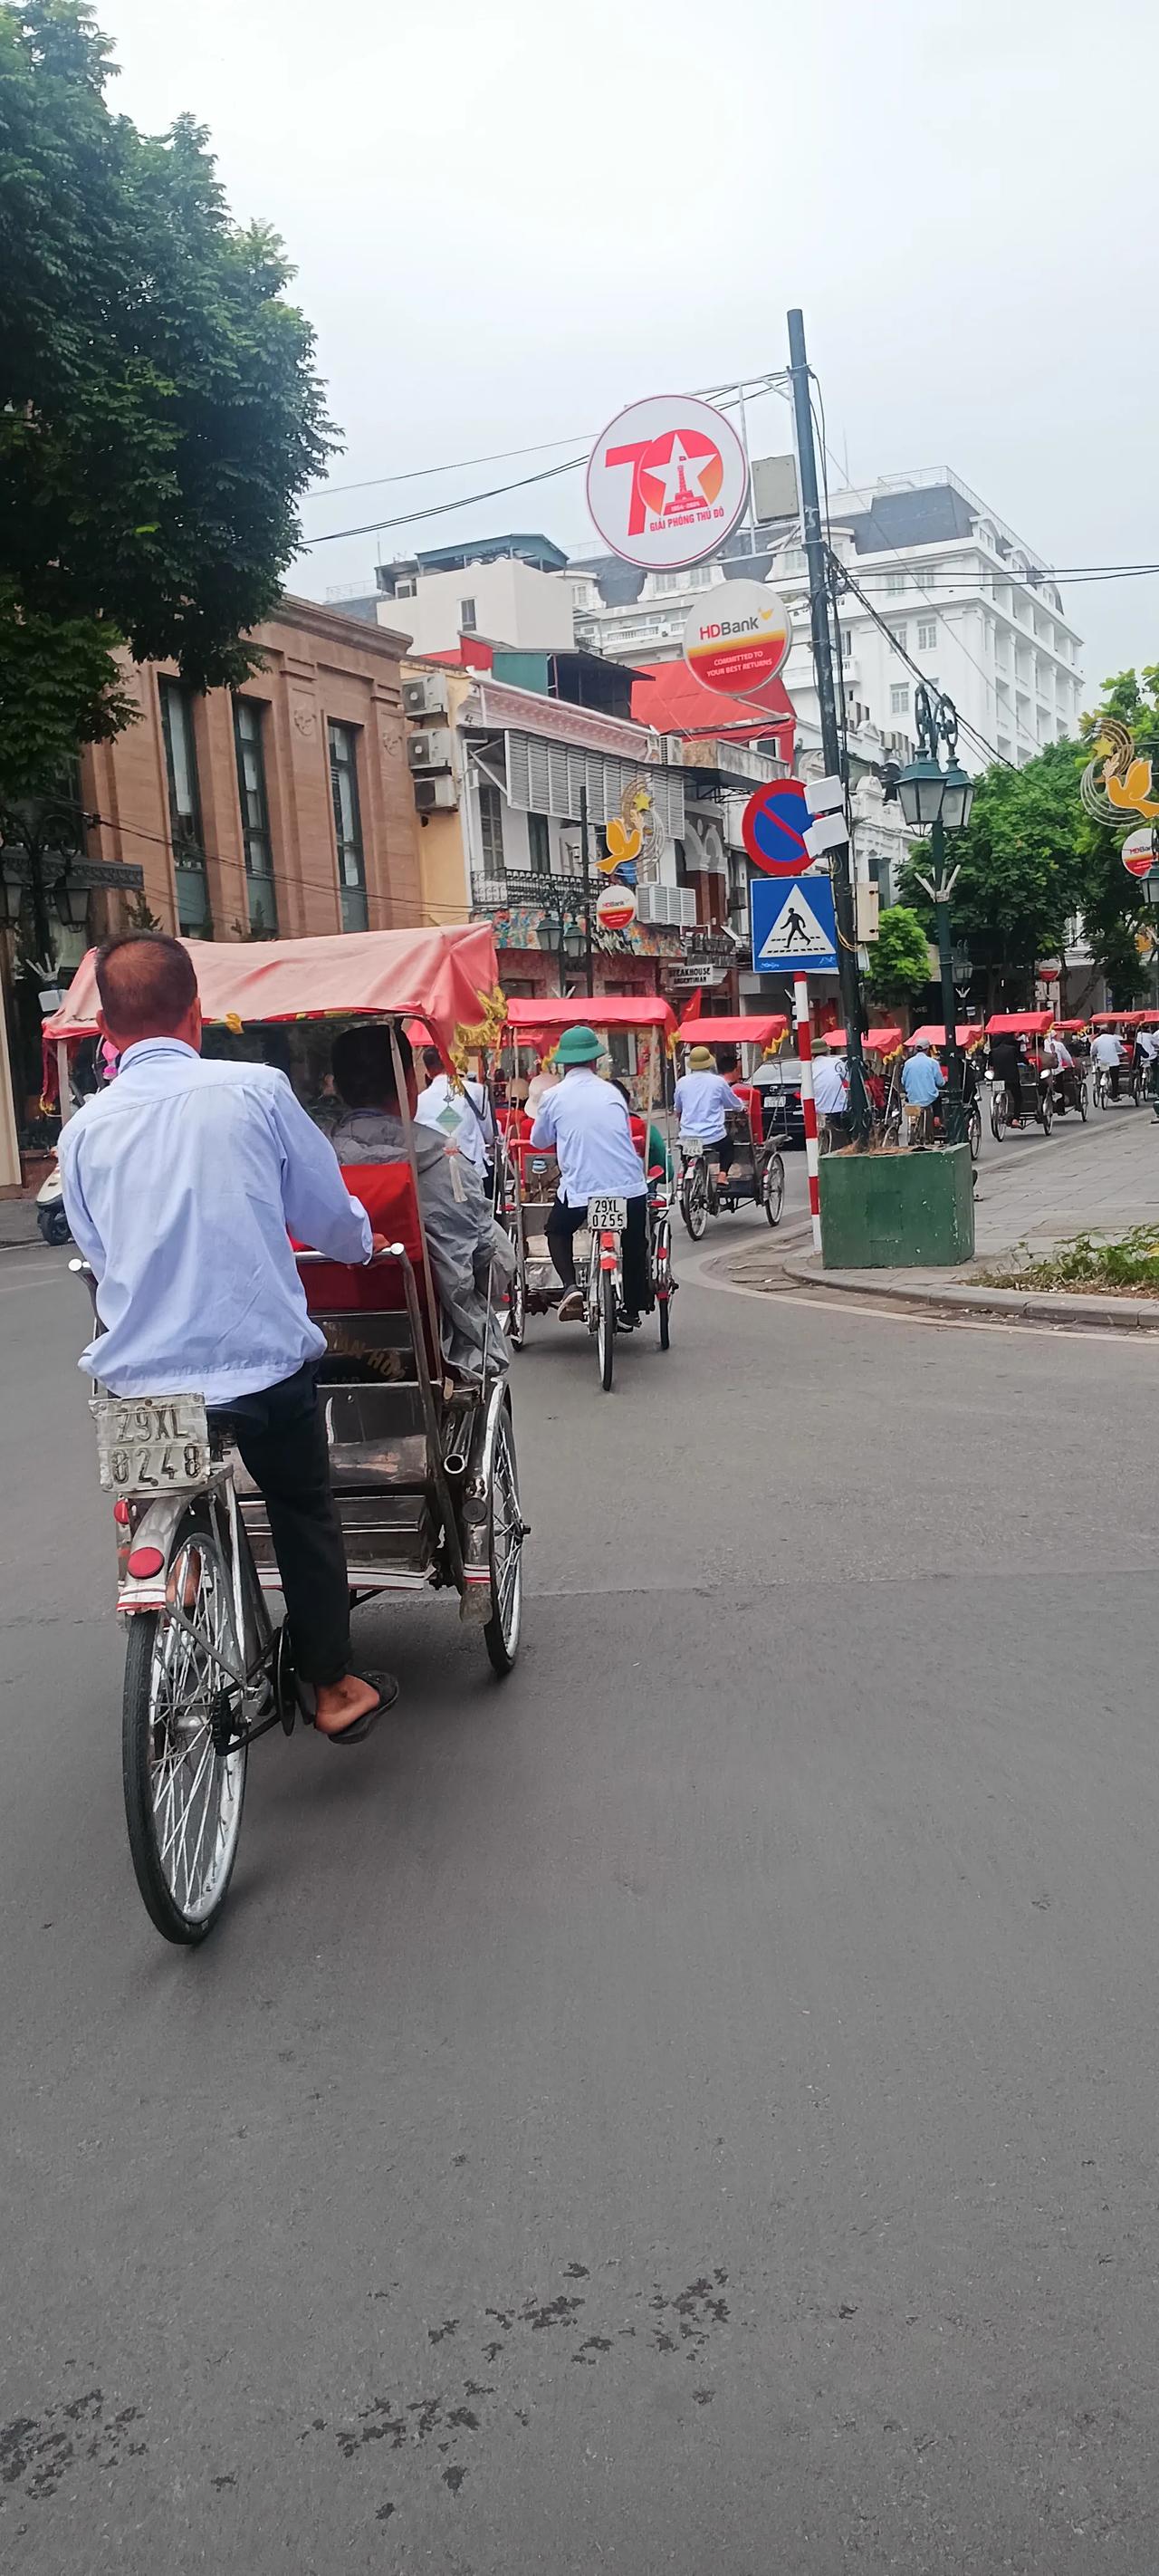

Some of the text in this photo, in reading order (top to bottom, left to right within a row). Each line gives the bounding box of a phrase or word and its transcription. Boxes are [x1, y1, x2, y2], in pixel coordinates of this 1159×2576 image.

[699, 617, 759, 640] HDBank
[714, 650, 763, 666] COMMITTED TO
[706, 658, 772, 678] YOUR BEST RETURNS
[595, 1200, 619, 1213] 29XL
[592, 1214, 623, 1227] 0255
[117, 1403, 190, 1443] 29XL
